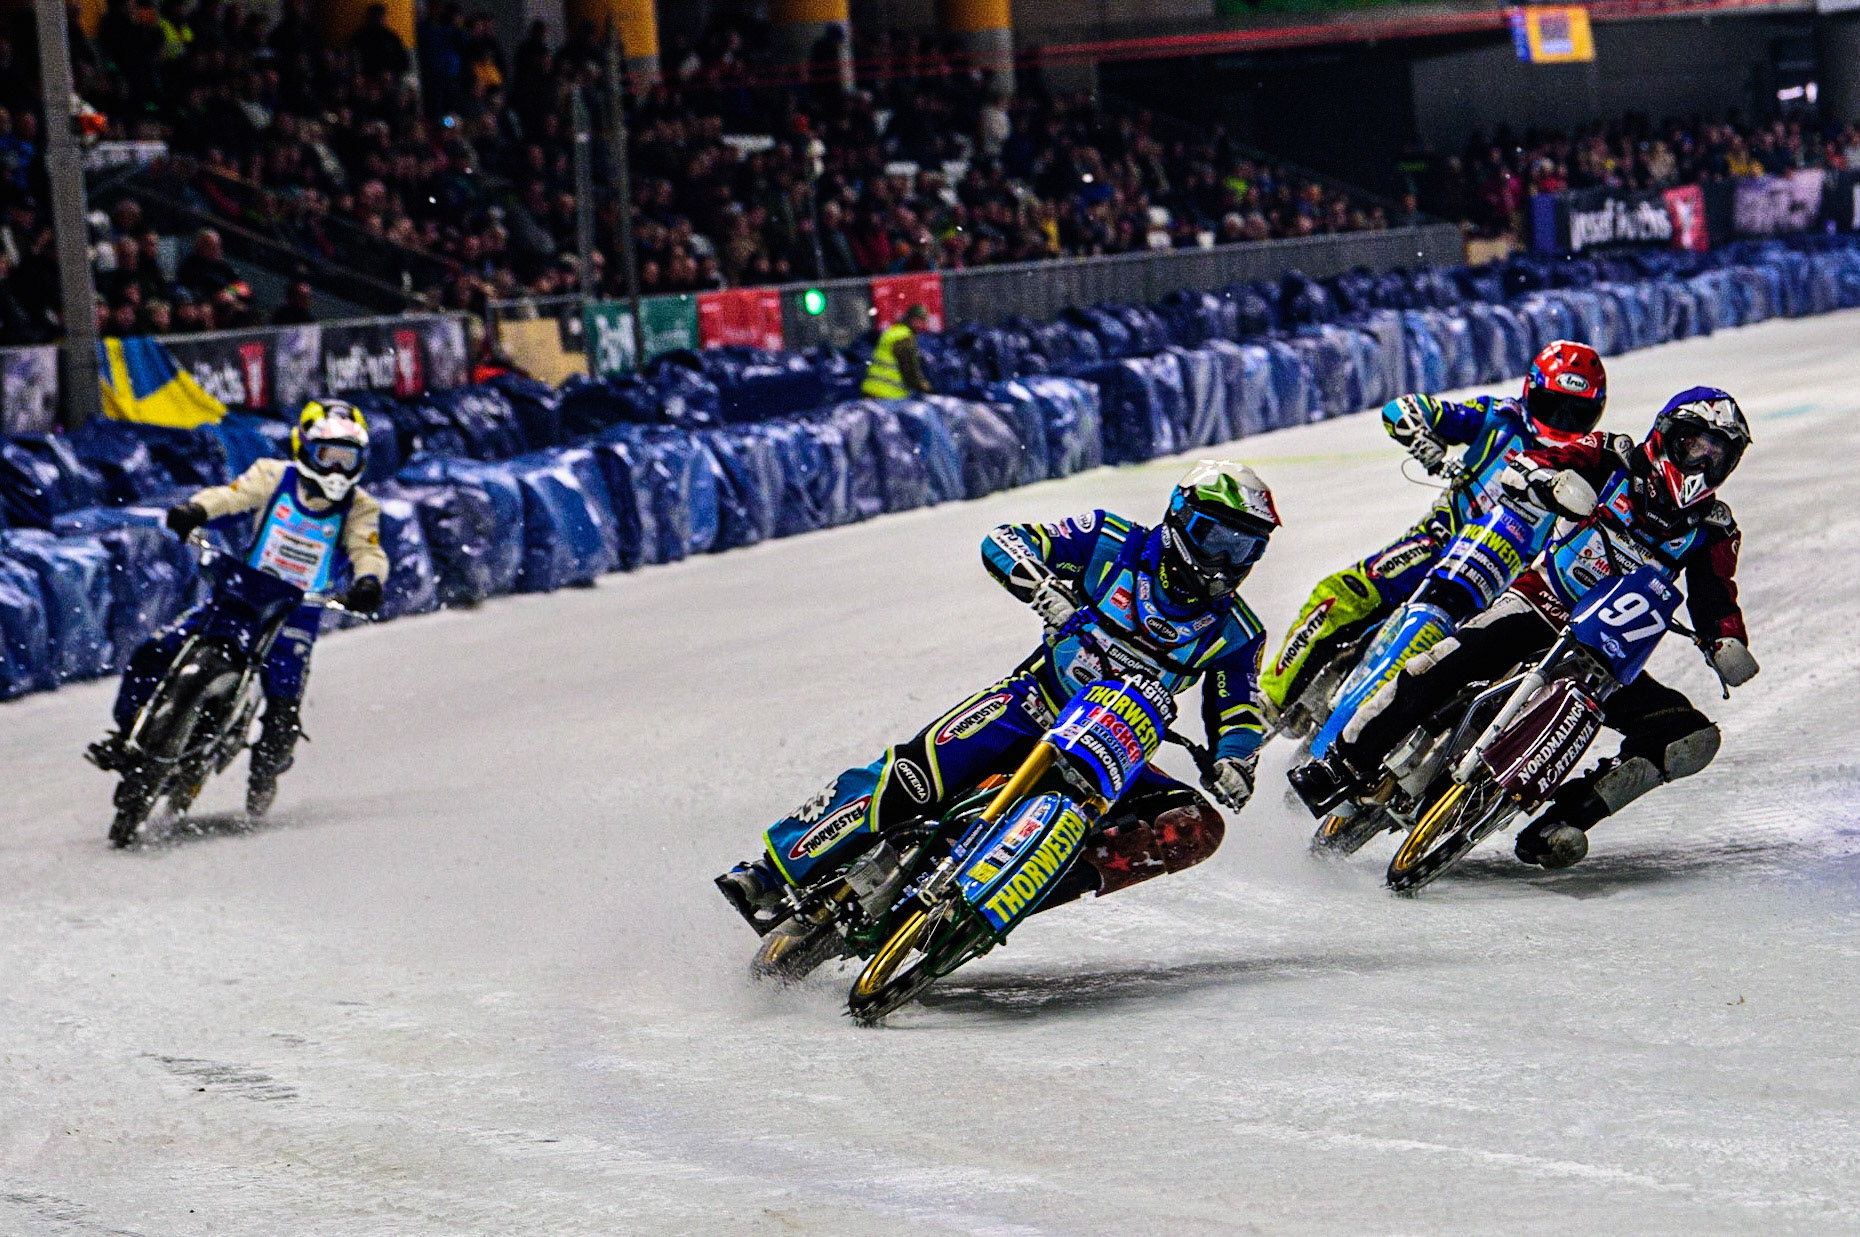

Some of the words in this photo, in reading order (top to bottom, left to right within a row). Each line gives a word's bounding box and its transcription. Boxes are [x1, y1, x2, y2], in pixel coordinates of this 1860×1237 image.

[1598, 592, 1666, 642] 97
[1131, 673, 1173, 721] Aigner
[1080, 734, 1123, 793] Silkolene
[1518, 700, 1586, 786] NORDMALINGS
[898, 763, 927, 799] ORTEMA
[802, 805, 865, 854] THORWESTER
